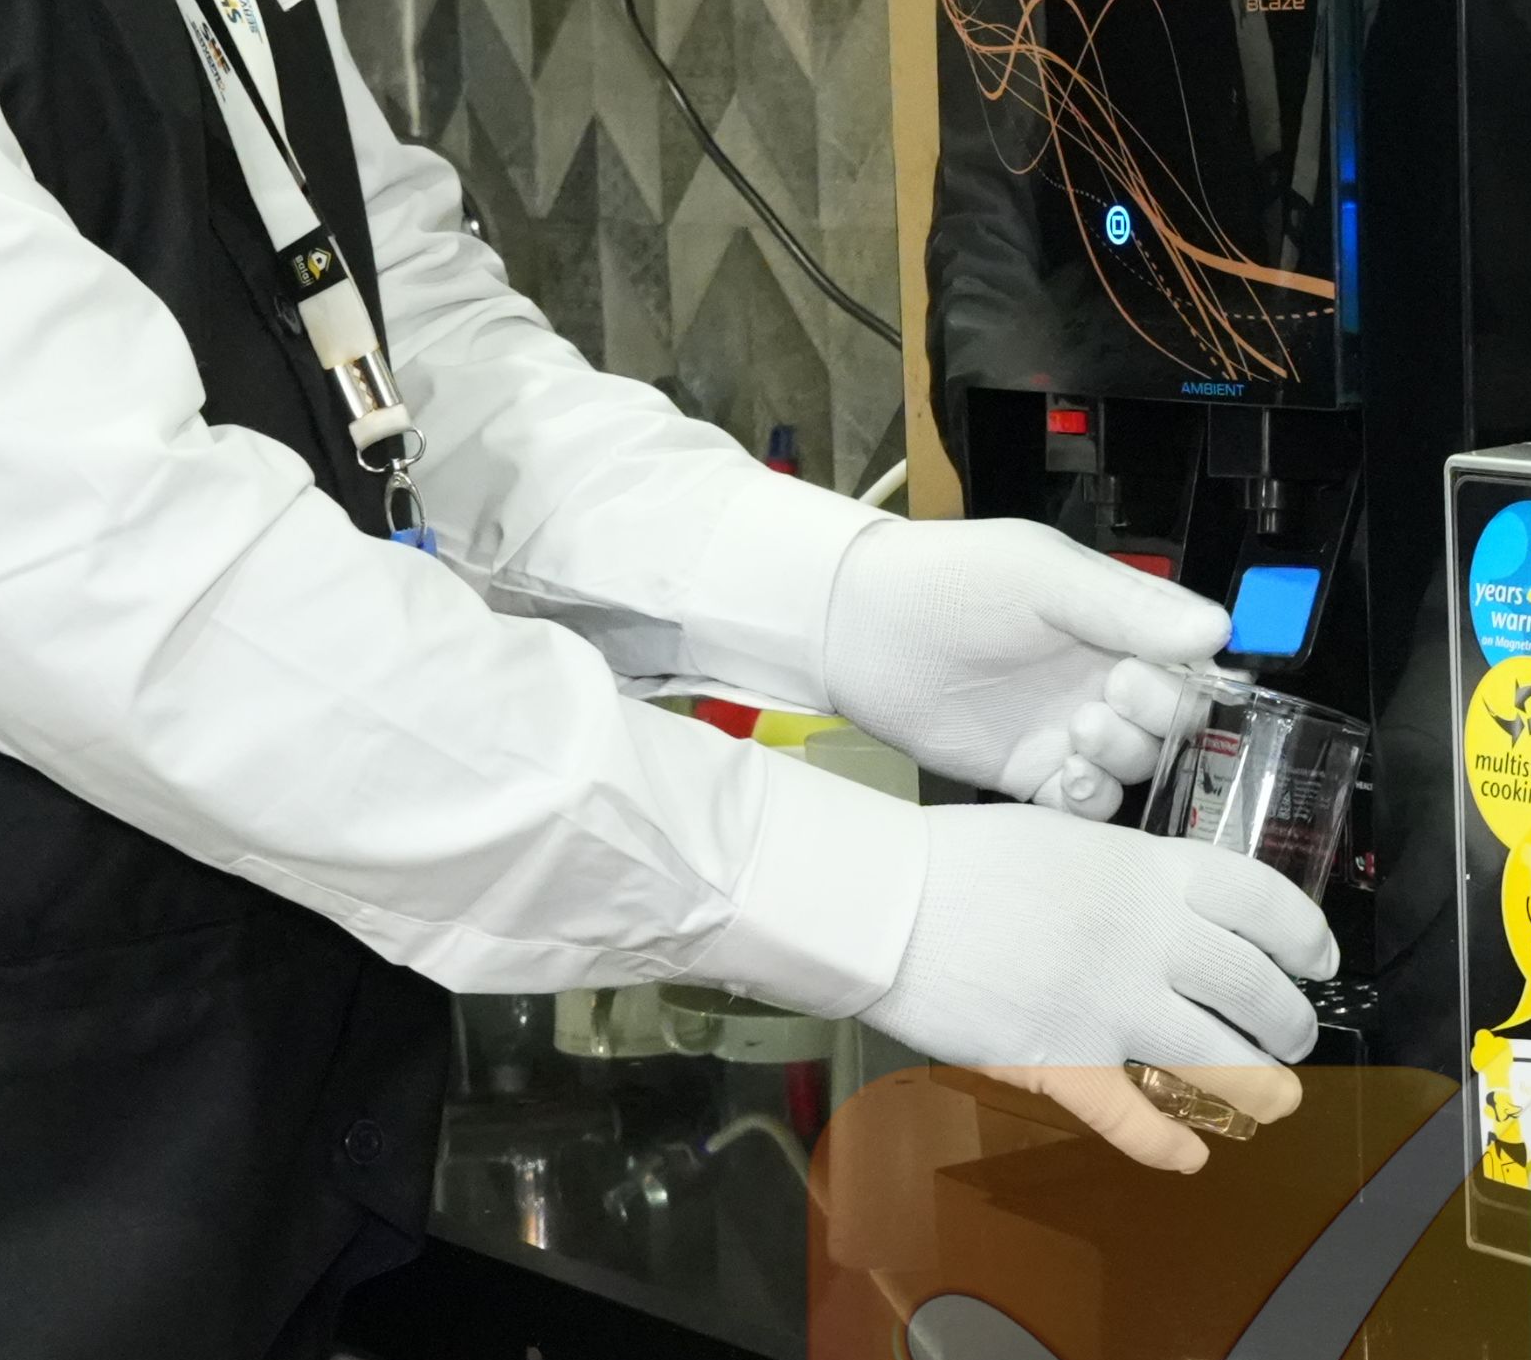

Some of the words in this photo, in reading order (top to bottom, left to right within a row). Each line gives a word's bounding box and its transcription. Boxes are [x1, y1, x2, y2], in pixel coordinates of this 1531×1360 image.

[1181, 381, 1245, 397] AMBIENT
[1475, 581, 1524, 607] years
[1481, 636, 1492, 645] on
